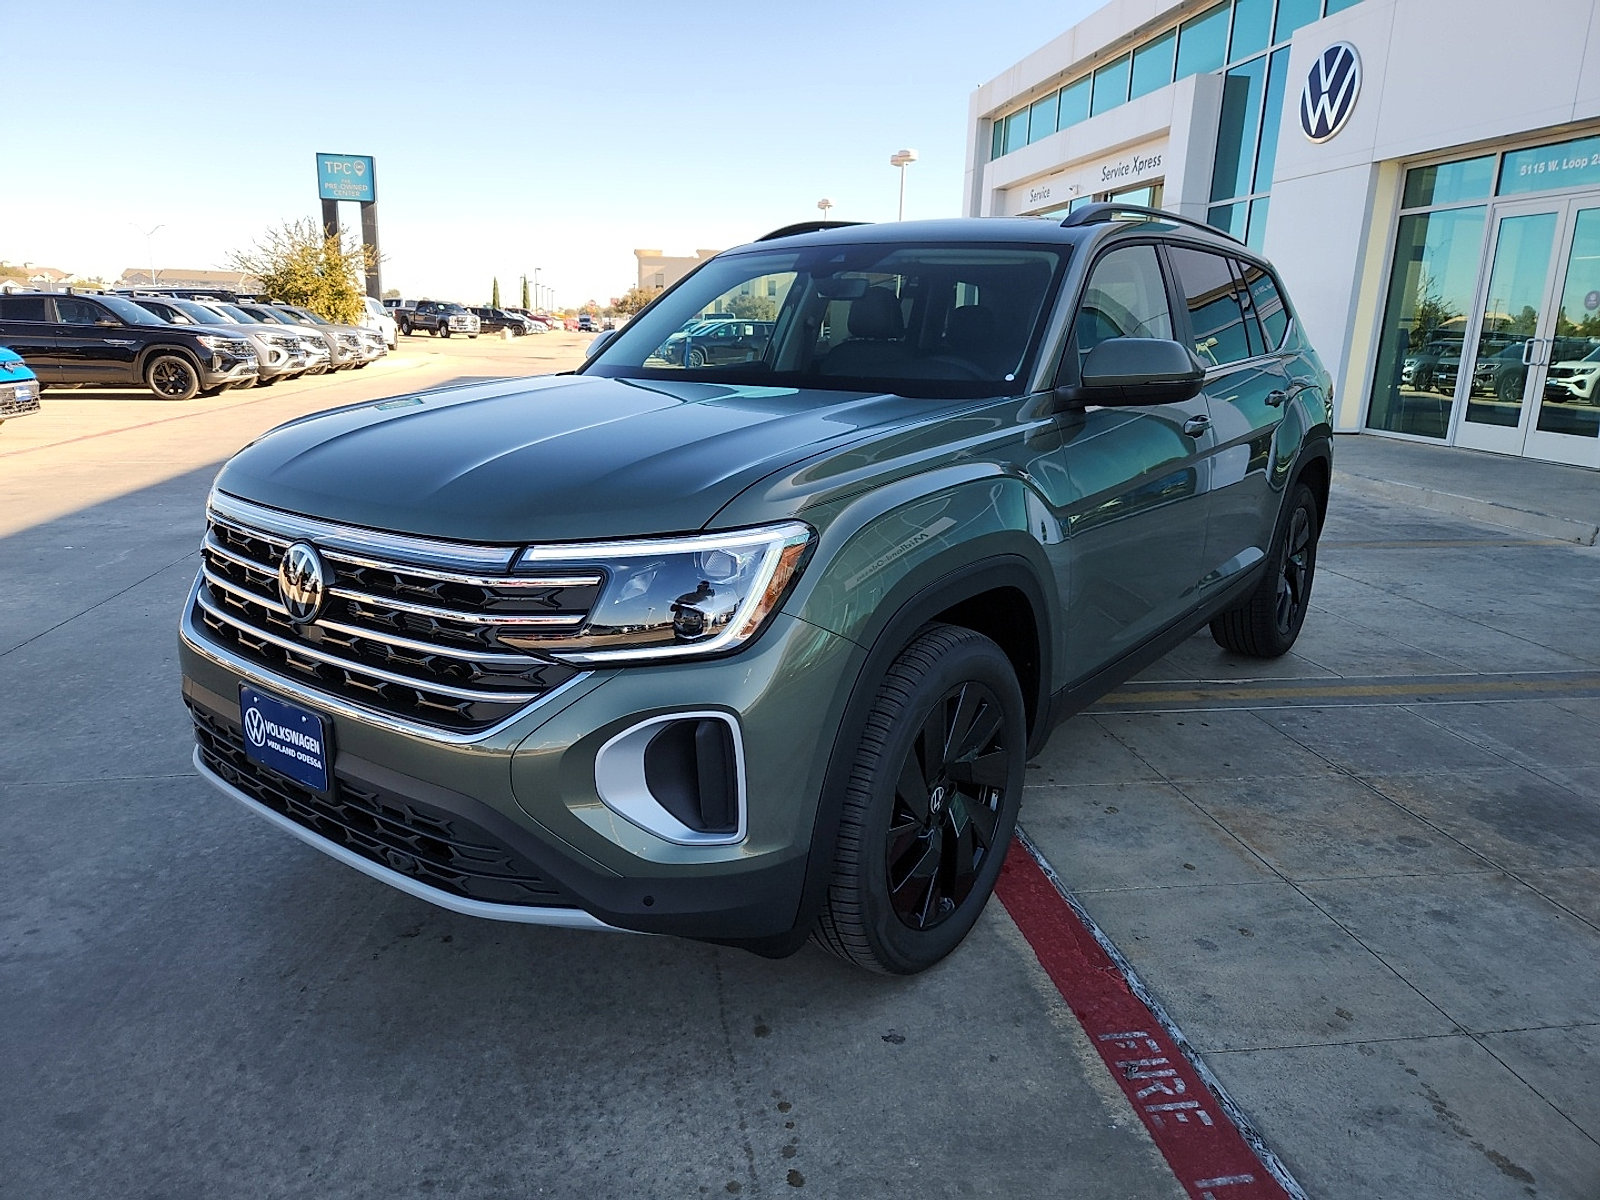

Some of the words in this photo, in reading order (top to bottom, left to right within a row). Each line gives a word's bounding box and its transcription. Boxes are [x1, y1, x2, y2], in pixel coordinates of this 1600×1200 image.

[324, 161, 352, 175] TPC
[1101, 163, 1130, 182] Service
[1131, 154, 1162, 176] Xpress
[1520, 161, 1546, 176] 5115
[1548, 159, 1559, 172] W.
[1562, 157, 1588, 170] Loop
[333, 189, 361, 197] CENTER
[1029, 187, 1051, 203] Service
[264, 719, 321, 755] VOLKSWAGEN
[266, 739, 296, 758] MIDLAND
[296, 751, 323, 770] ODESSA
[1098, 1031, 1214, 1129] FIRE
